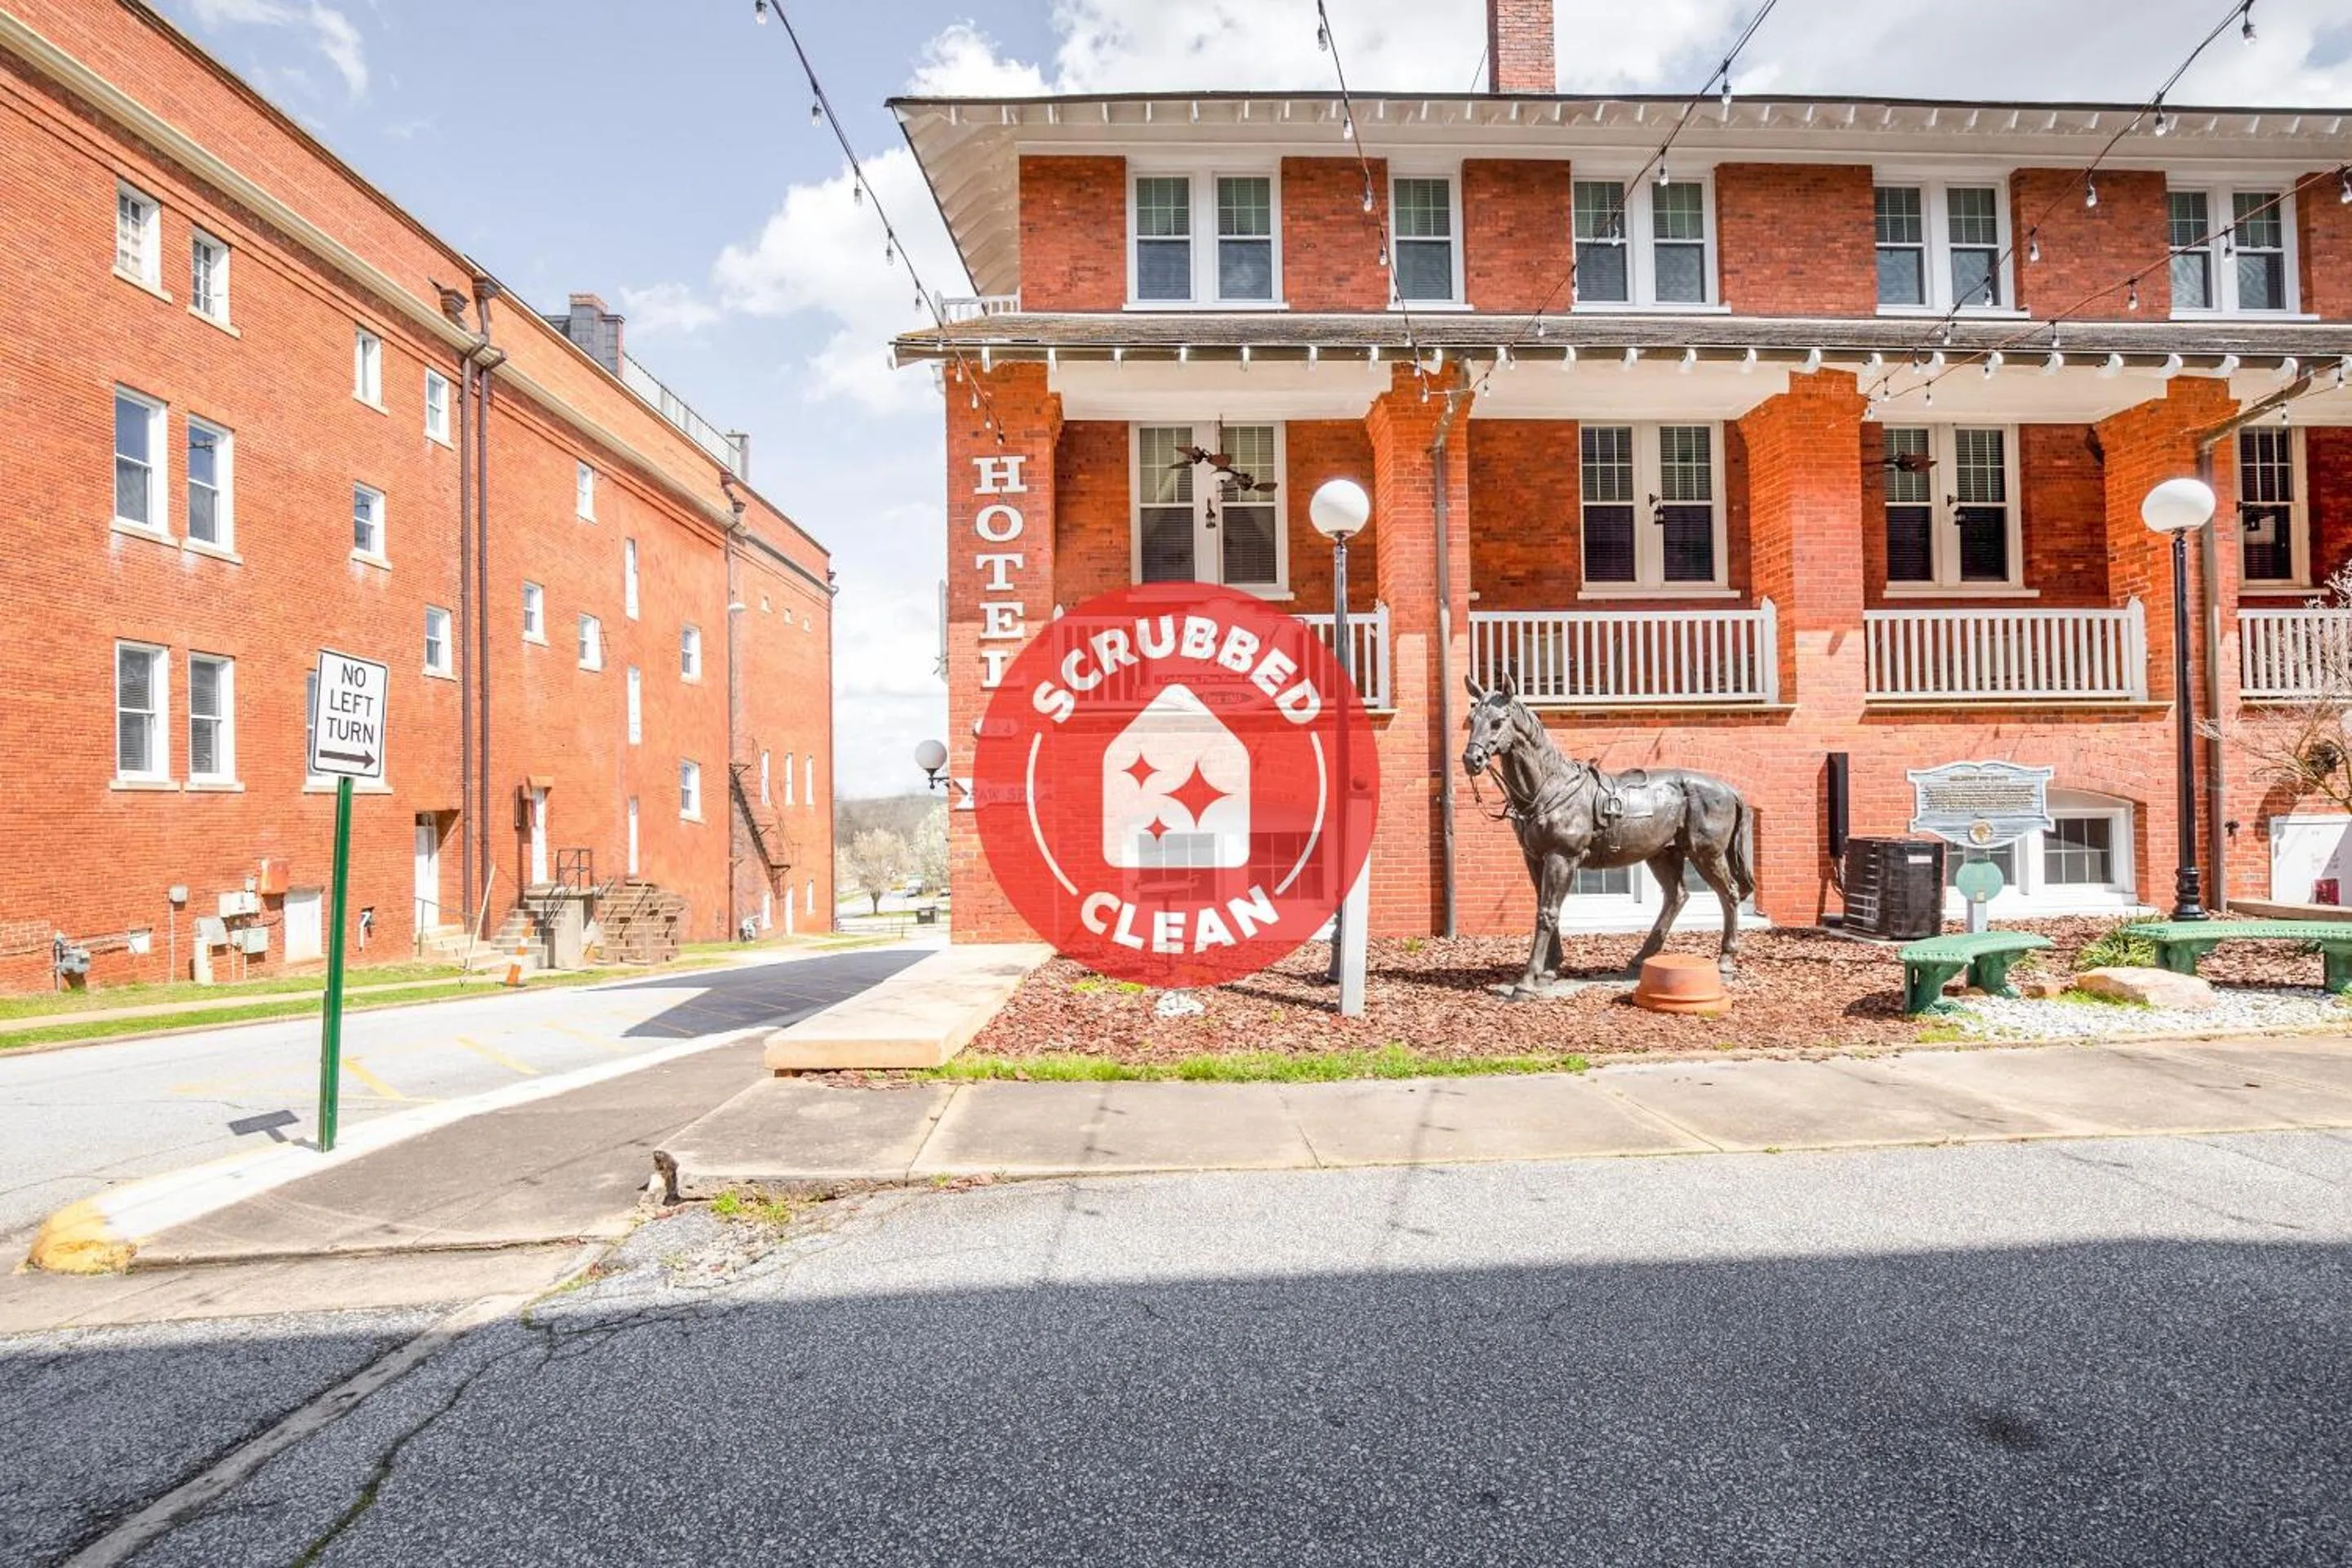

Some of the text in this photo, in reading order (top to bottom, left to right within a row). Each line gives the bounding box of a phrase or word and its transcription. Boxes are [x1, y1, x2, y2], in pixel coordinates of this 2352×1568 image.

[973, 456, 1027, 688] HOTEL
[341, 662, 366, 688] NO
[329, 689, 374, 717] LEFT
[327, 717, 374, 744] TURN
